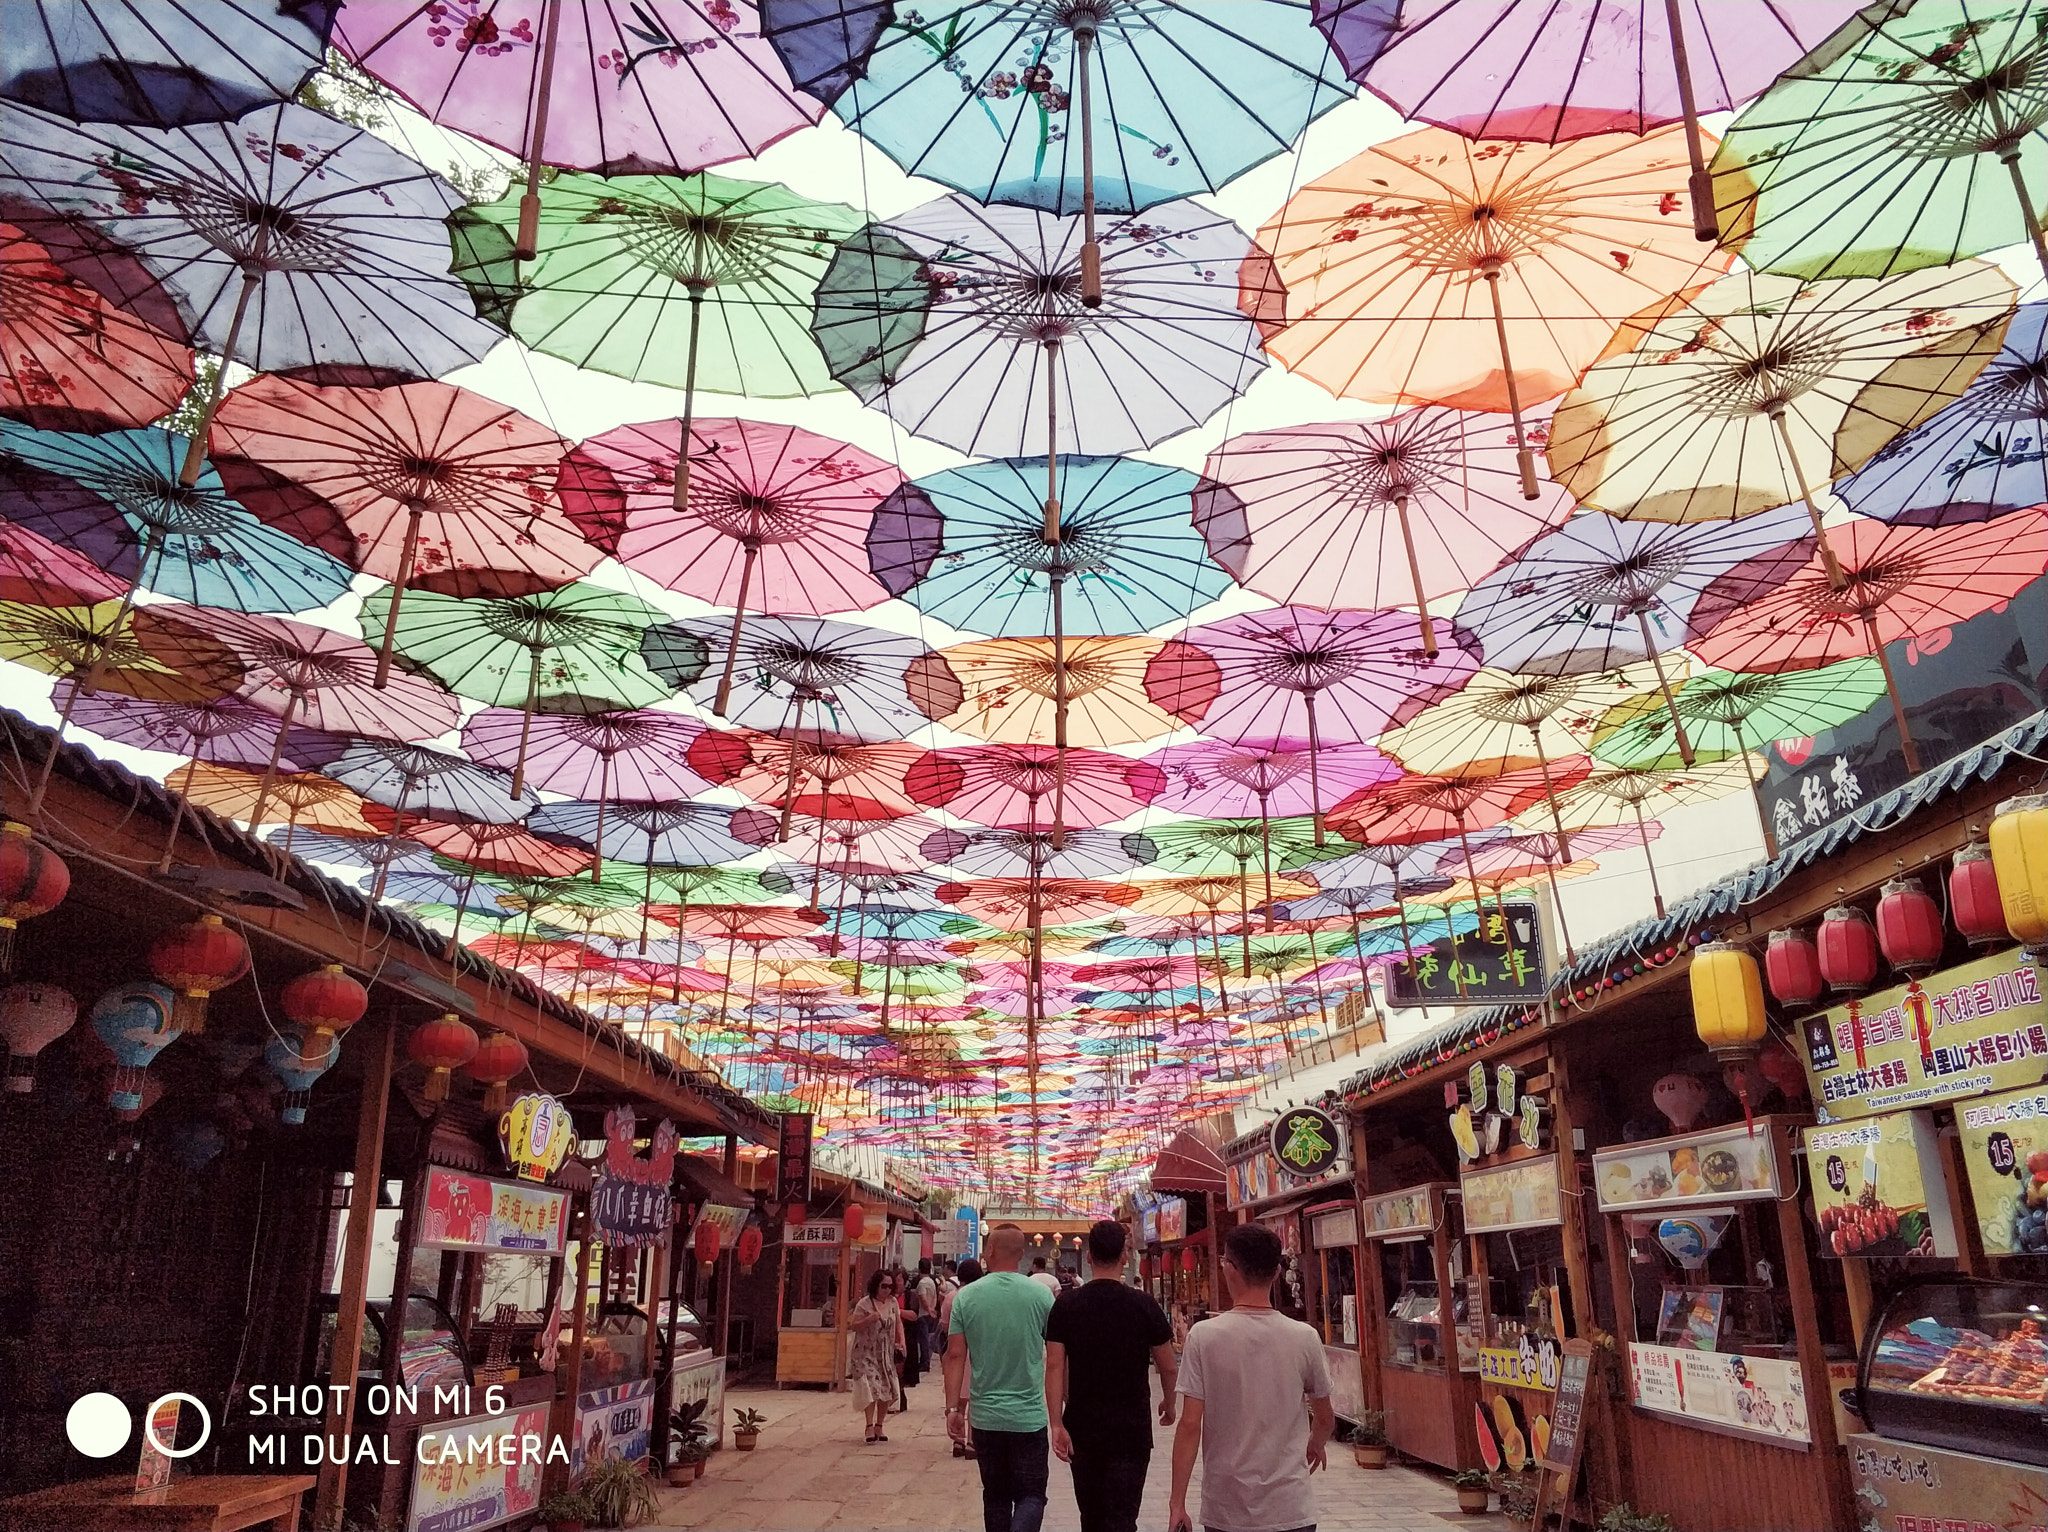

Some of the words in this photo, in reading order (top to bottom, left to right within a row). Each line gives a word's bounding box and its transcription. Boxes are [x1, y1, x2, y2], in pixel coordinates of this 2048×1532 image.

[1867, 1093, 1902, 1110] Taiwanese
[1903, 1088, 1933, 1102] sausage
[1933, 1083, 1951, 1096] with
[1951, 1077, 1975, 1093] sticky
[1975, 1074, 1993, 1088] rice
[1991, 1139, 2015, 1167] 15
[1828, 1162, 1845, 1185] 15
